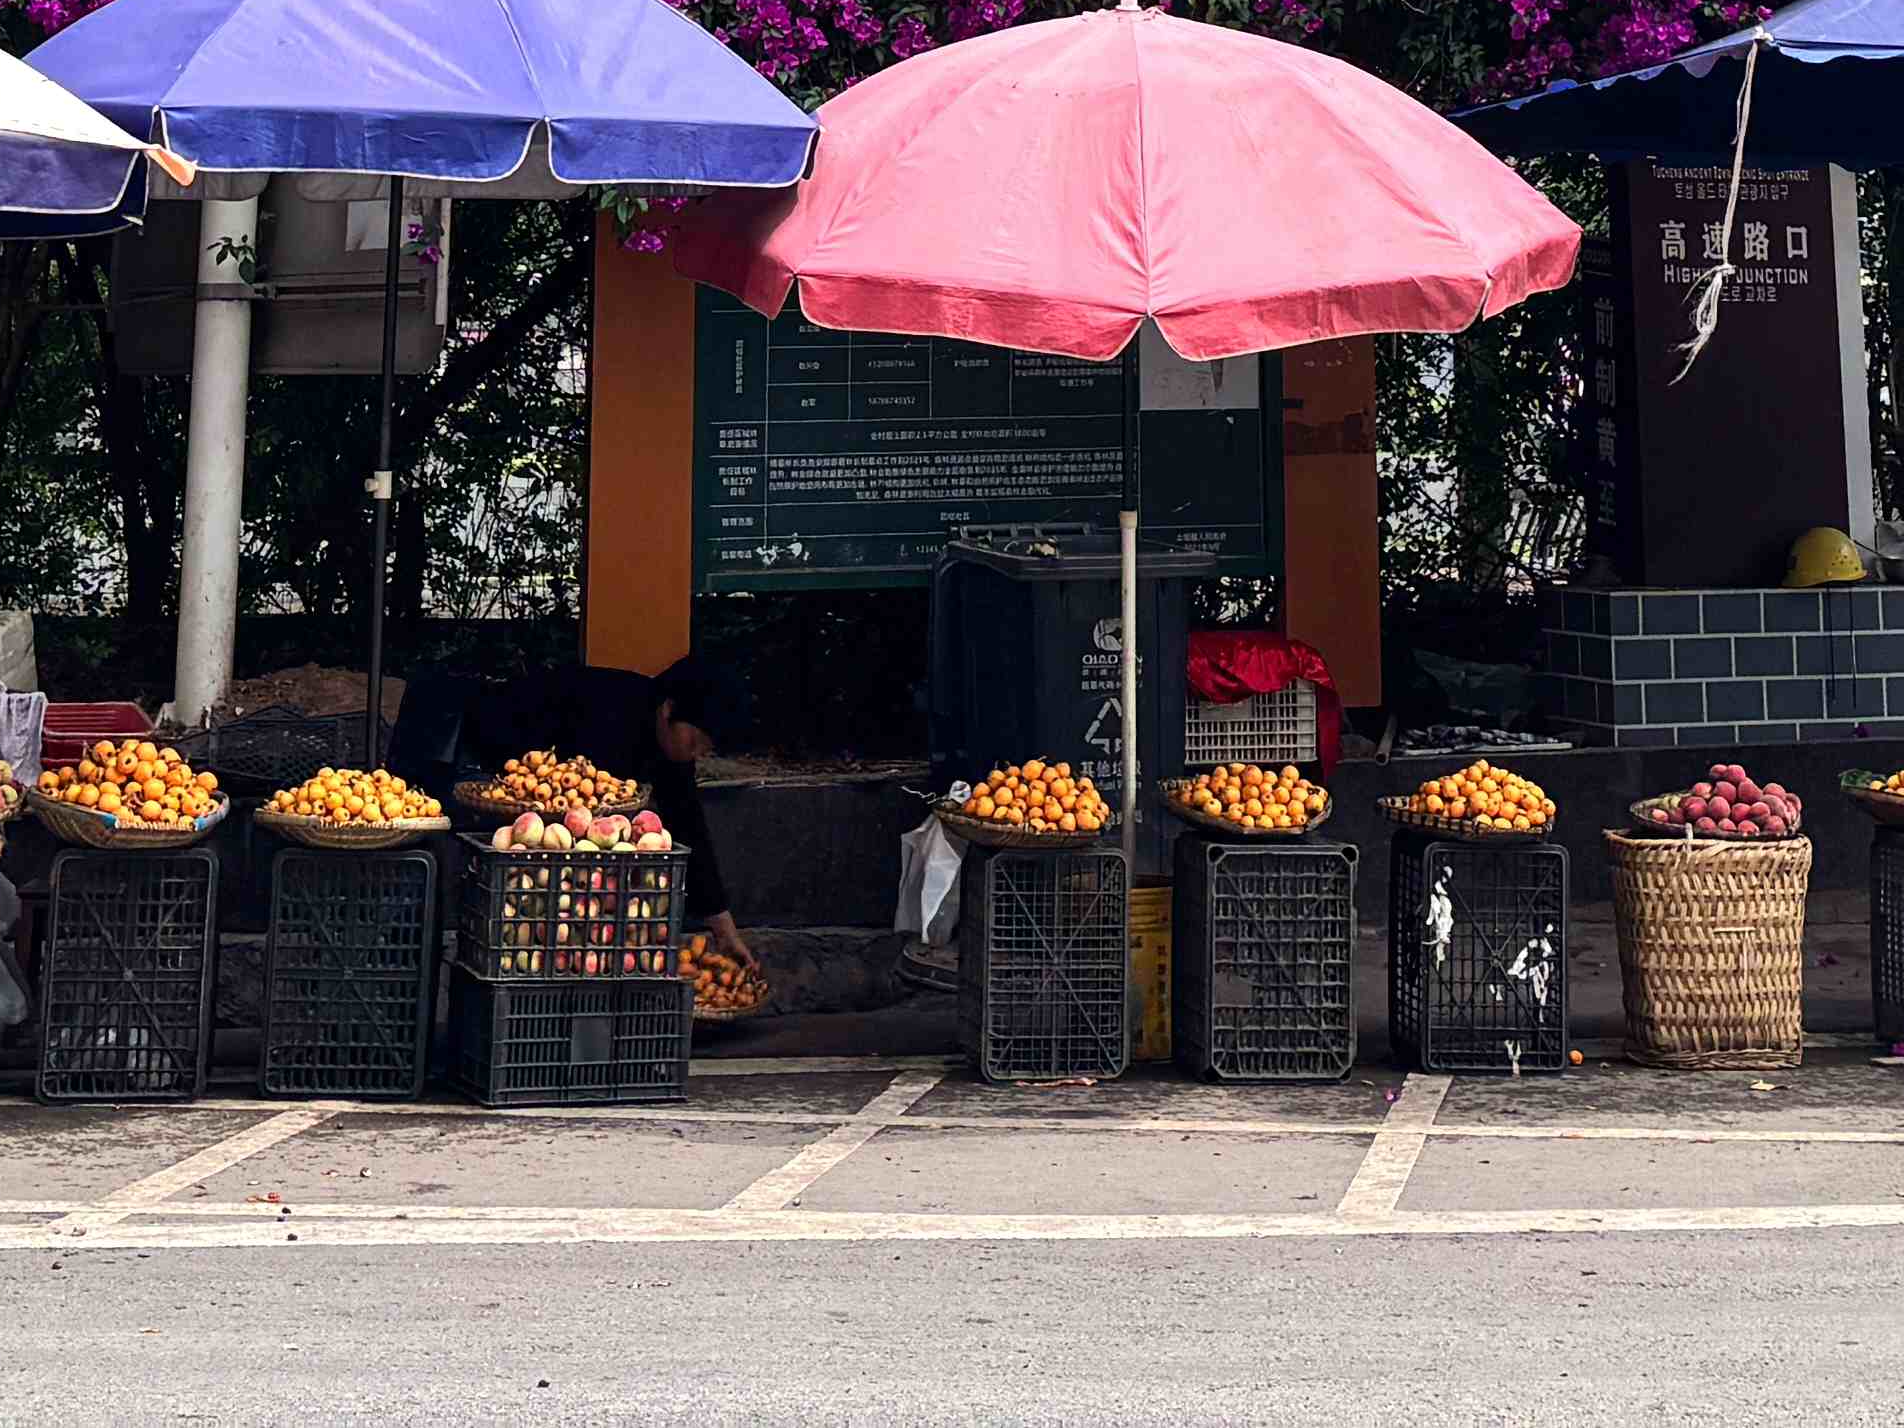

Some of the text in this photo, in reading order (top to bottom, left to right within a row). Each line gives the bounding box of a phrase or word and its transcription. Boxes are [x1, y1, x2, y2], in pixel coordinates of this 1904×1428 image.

[1659, 220, 1809, 262] 高速路口
[1736, 267, 1809, 285] JUNCTION
